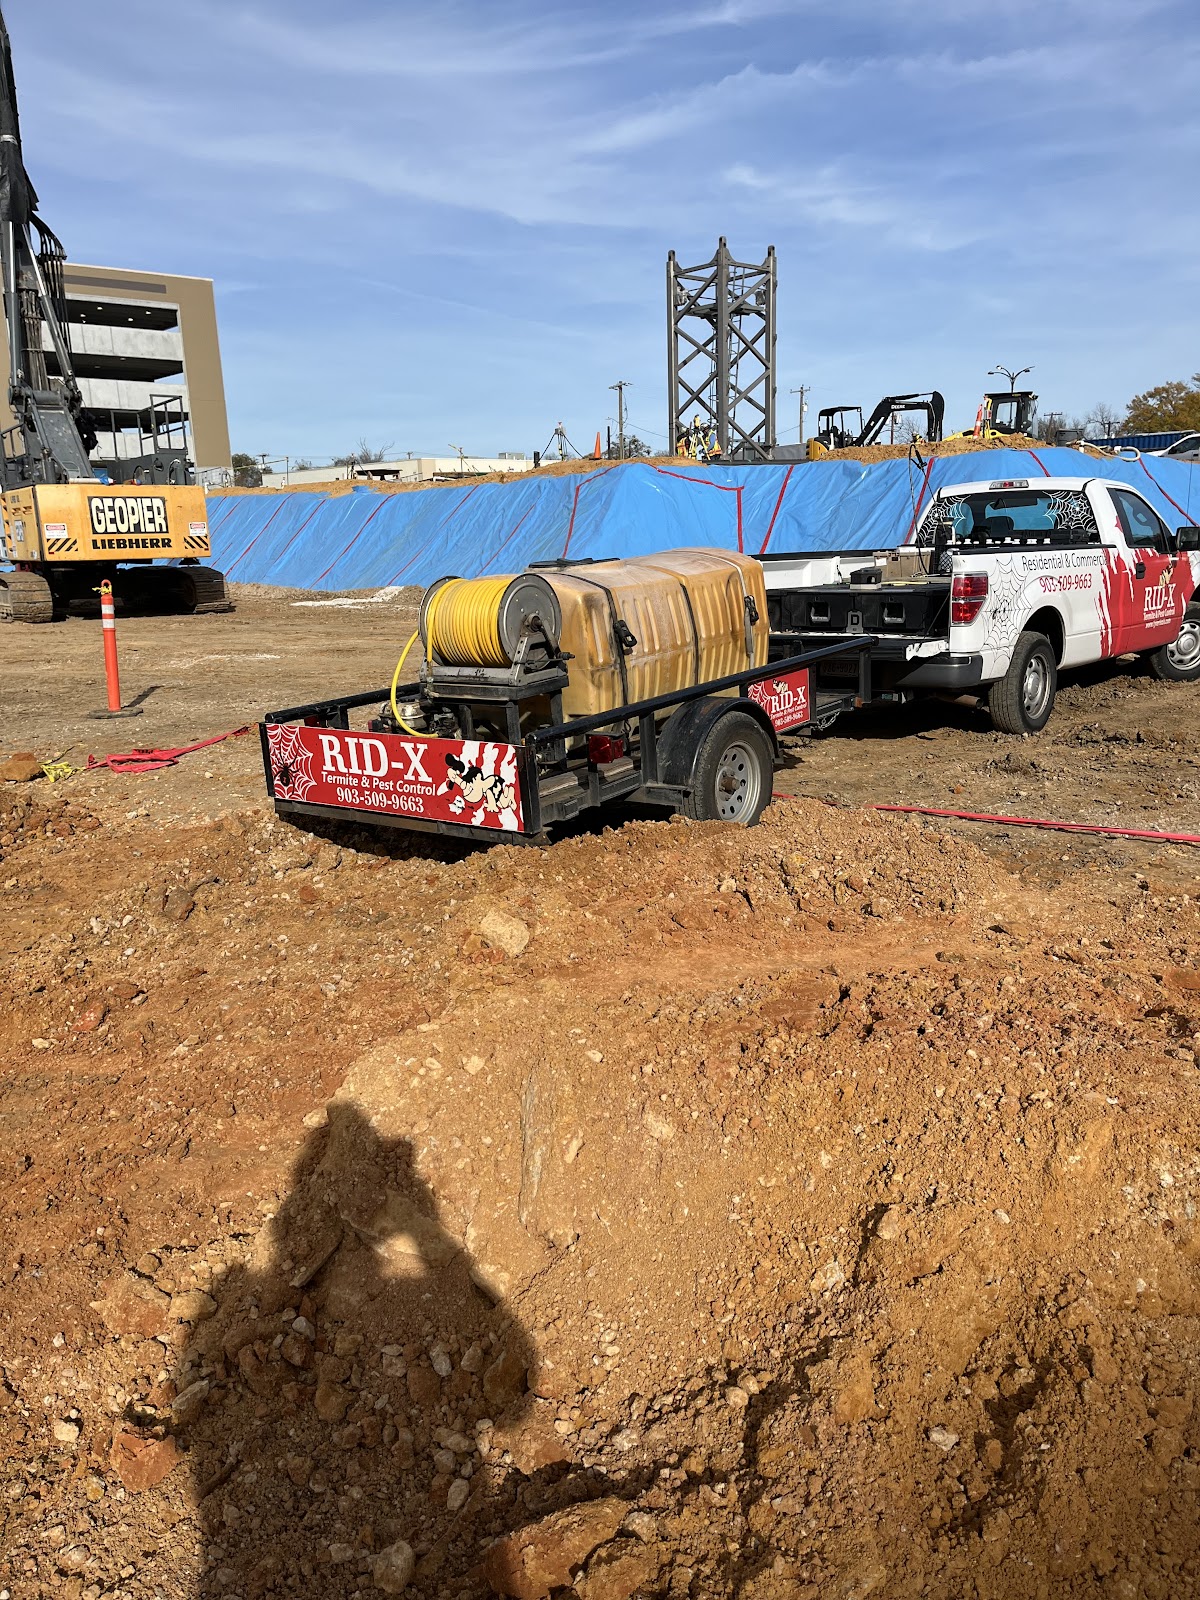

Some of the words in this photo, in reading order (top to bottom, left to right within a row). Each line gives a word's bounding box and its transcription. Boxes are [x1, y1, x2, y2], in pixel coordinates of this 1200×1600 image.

[91, 497, 168, 533] GEOPIER
[92, 538, 172, 550] LIEBHERR
[1022, 553, 1063, 571] Residential
[1065, 553, 1071, 568] &
[1072, 552, 1109, 568] Commercia
[1039, 573, 1093, 593] 903-509-9663
[1143, 583, 1176, 611] RID-X
[771, 686, 806, 714] RID-X
[318, 734, 432, 783] RID-X
[321, 771, 358, 787] Termite
[361, 775, 370, 788] &
[372, 777, 394, 791] Pest
[396, 780, 436, 796] Control
[336, 786, 425, 813] 903-509-9663
